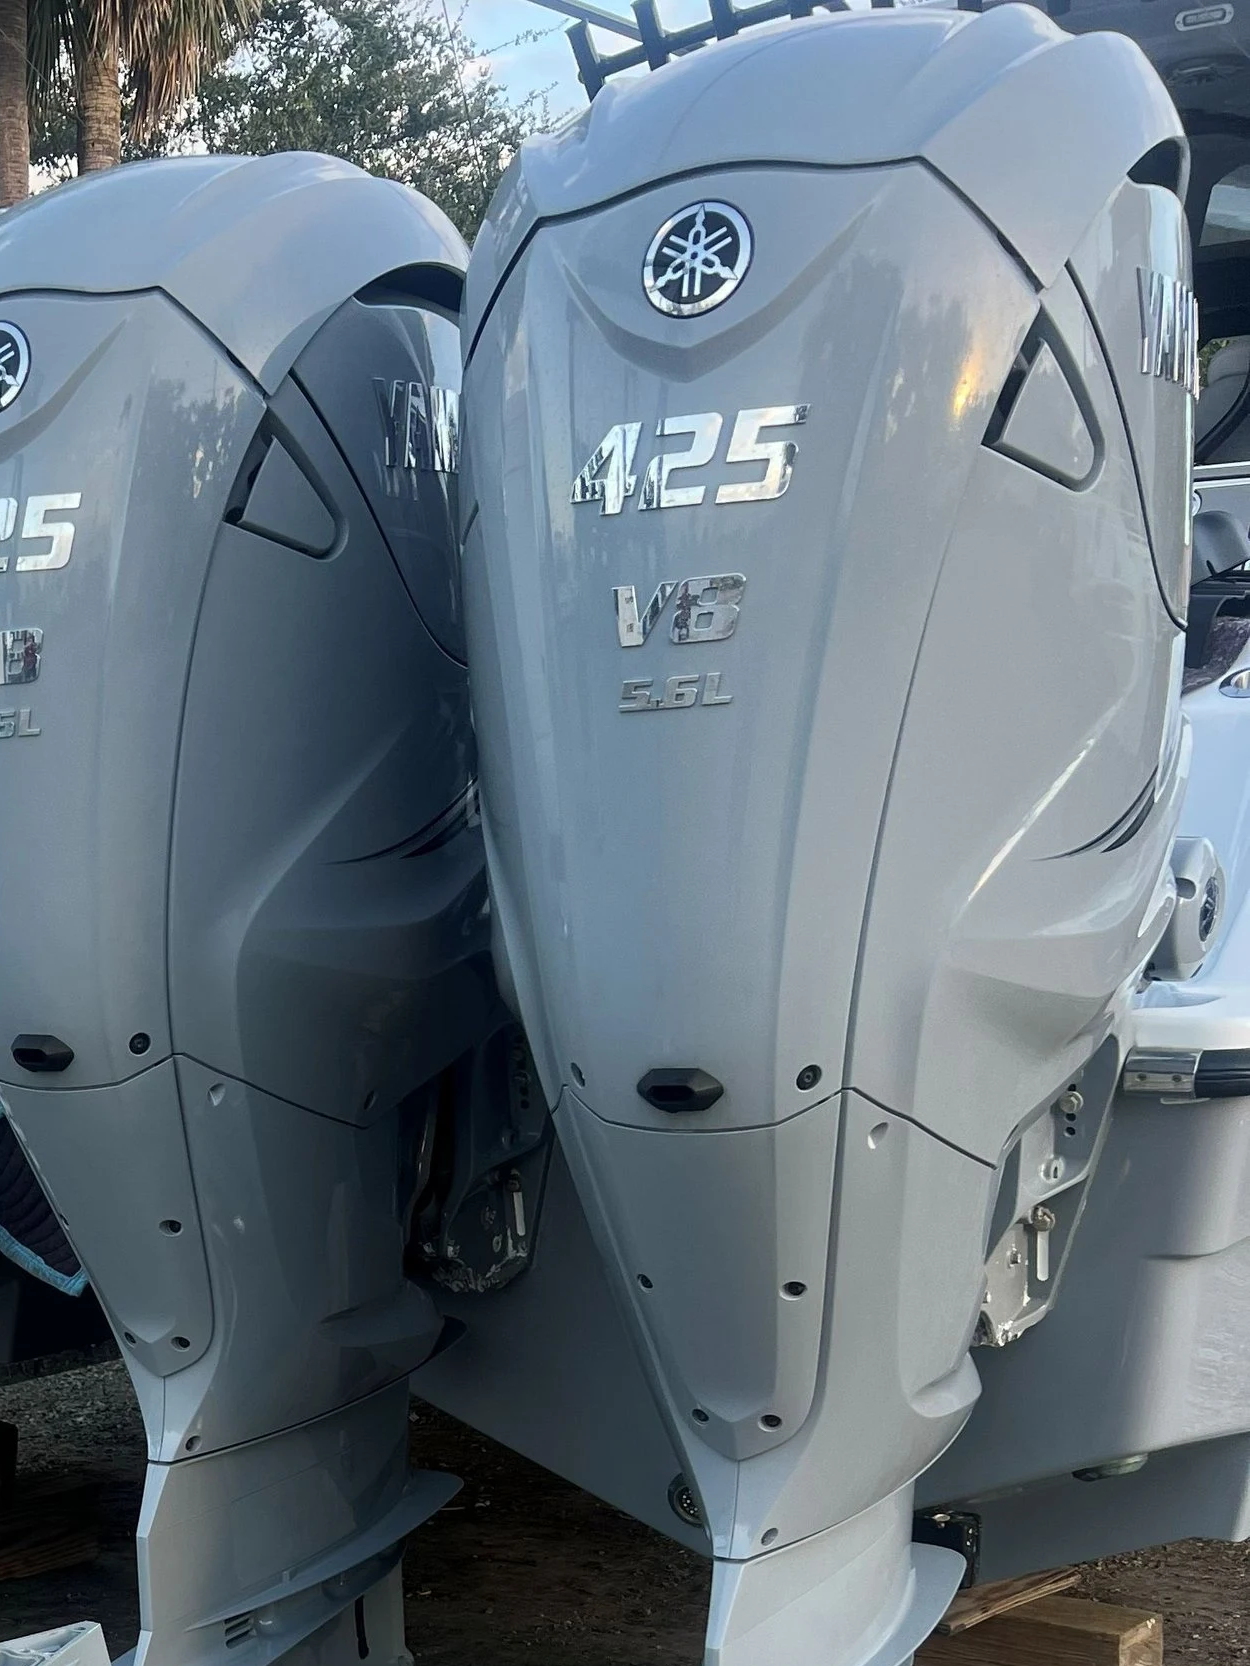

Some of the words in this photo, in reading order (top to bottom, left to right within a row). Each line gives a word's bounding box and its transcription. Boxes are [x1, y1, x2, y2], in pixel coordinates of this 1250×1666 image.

[570, 403, 812, 516] 425
[611, 572, 747, 648] V8
[618, 671, 734, 713] 5.6L
